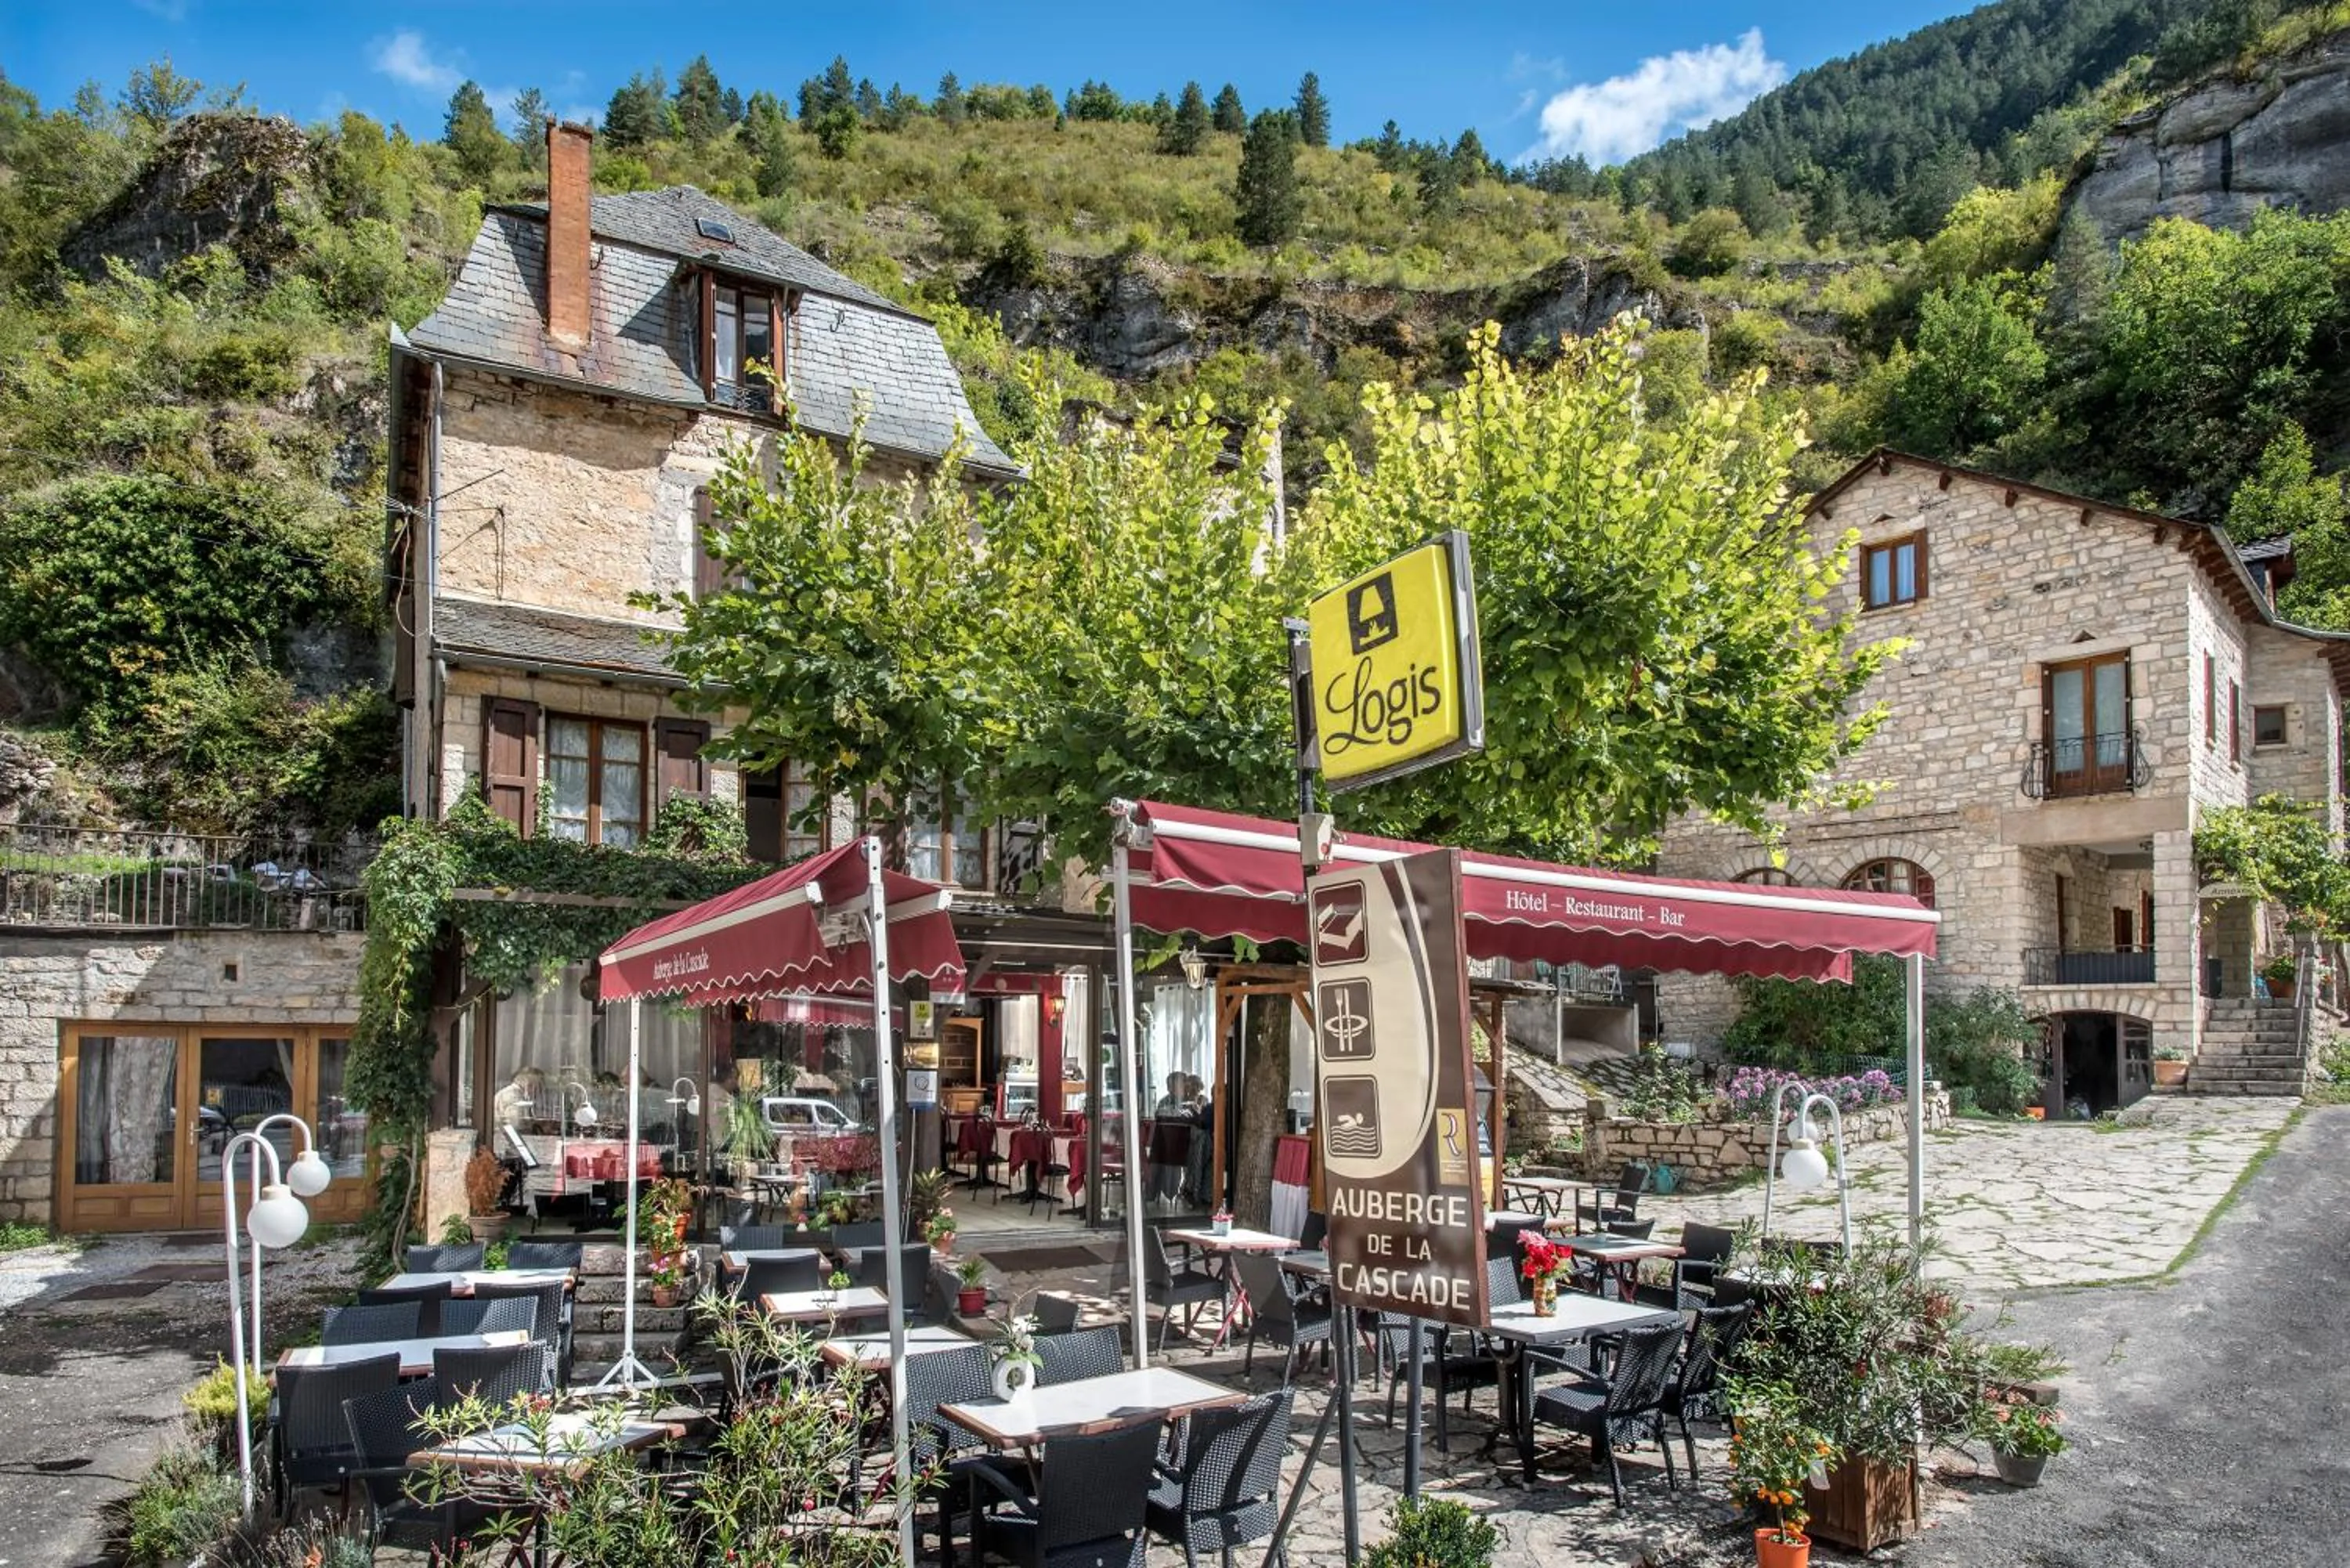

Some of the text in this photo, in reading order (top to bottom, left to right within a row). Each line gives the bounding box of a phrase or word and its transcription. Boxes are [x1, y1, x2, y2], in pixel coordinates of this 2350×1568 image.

[1324, 656, 1441, 755] Logis
[1506, 891, 1548, 912] Hôtel
[1566, 897, 1644, 922] Restaurant
[1660, 906, 1685, 927] Bar
[1332, 1187, 1467, 1227] AUBERGE
[1367, 1234, 1432, 1260] DE LA
[1337, 1262, 1470, 1311] CASCADE
